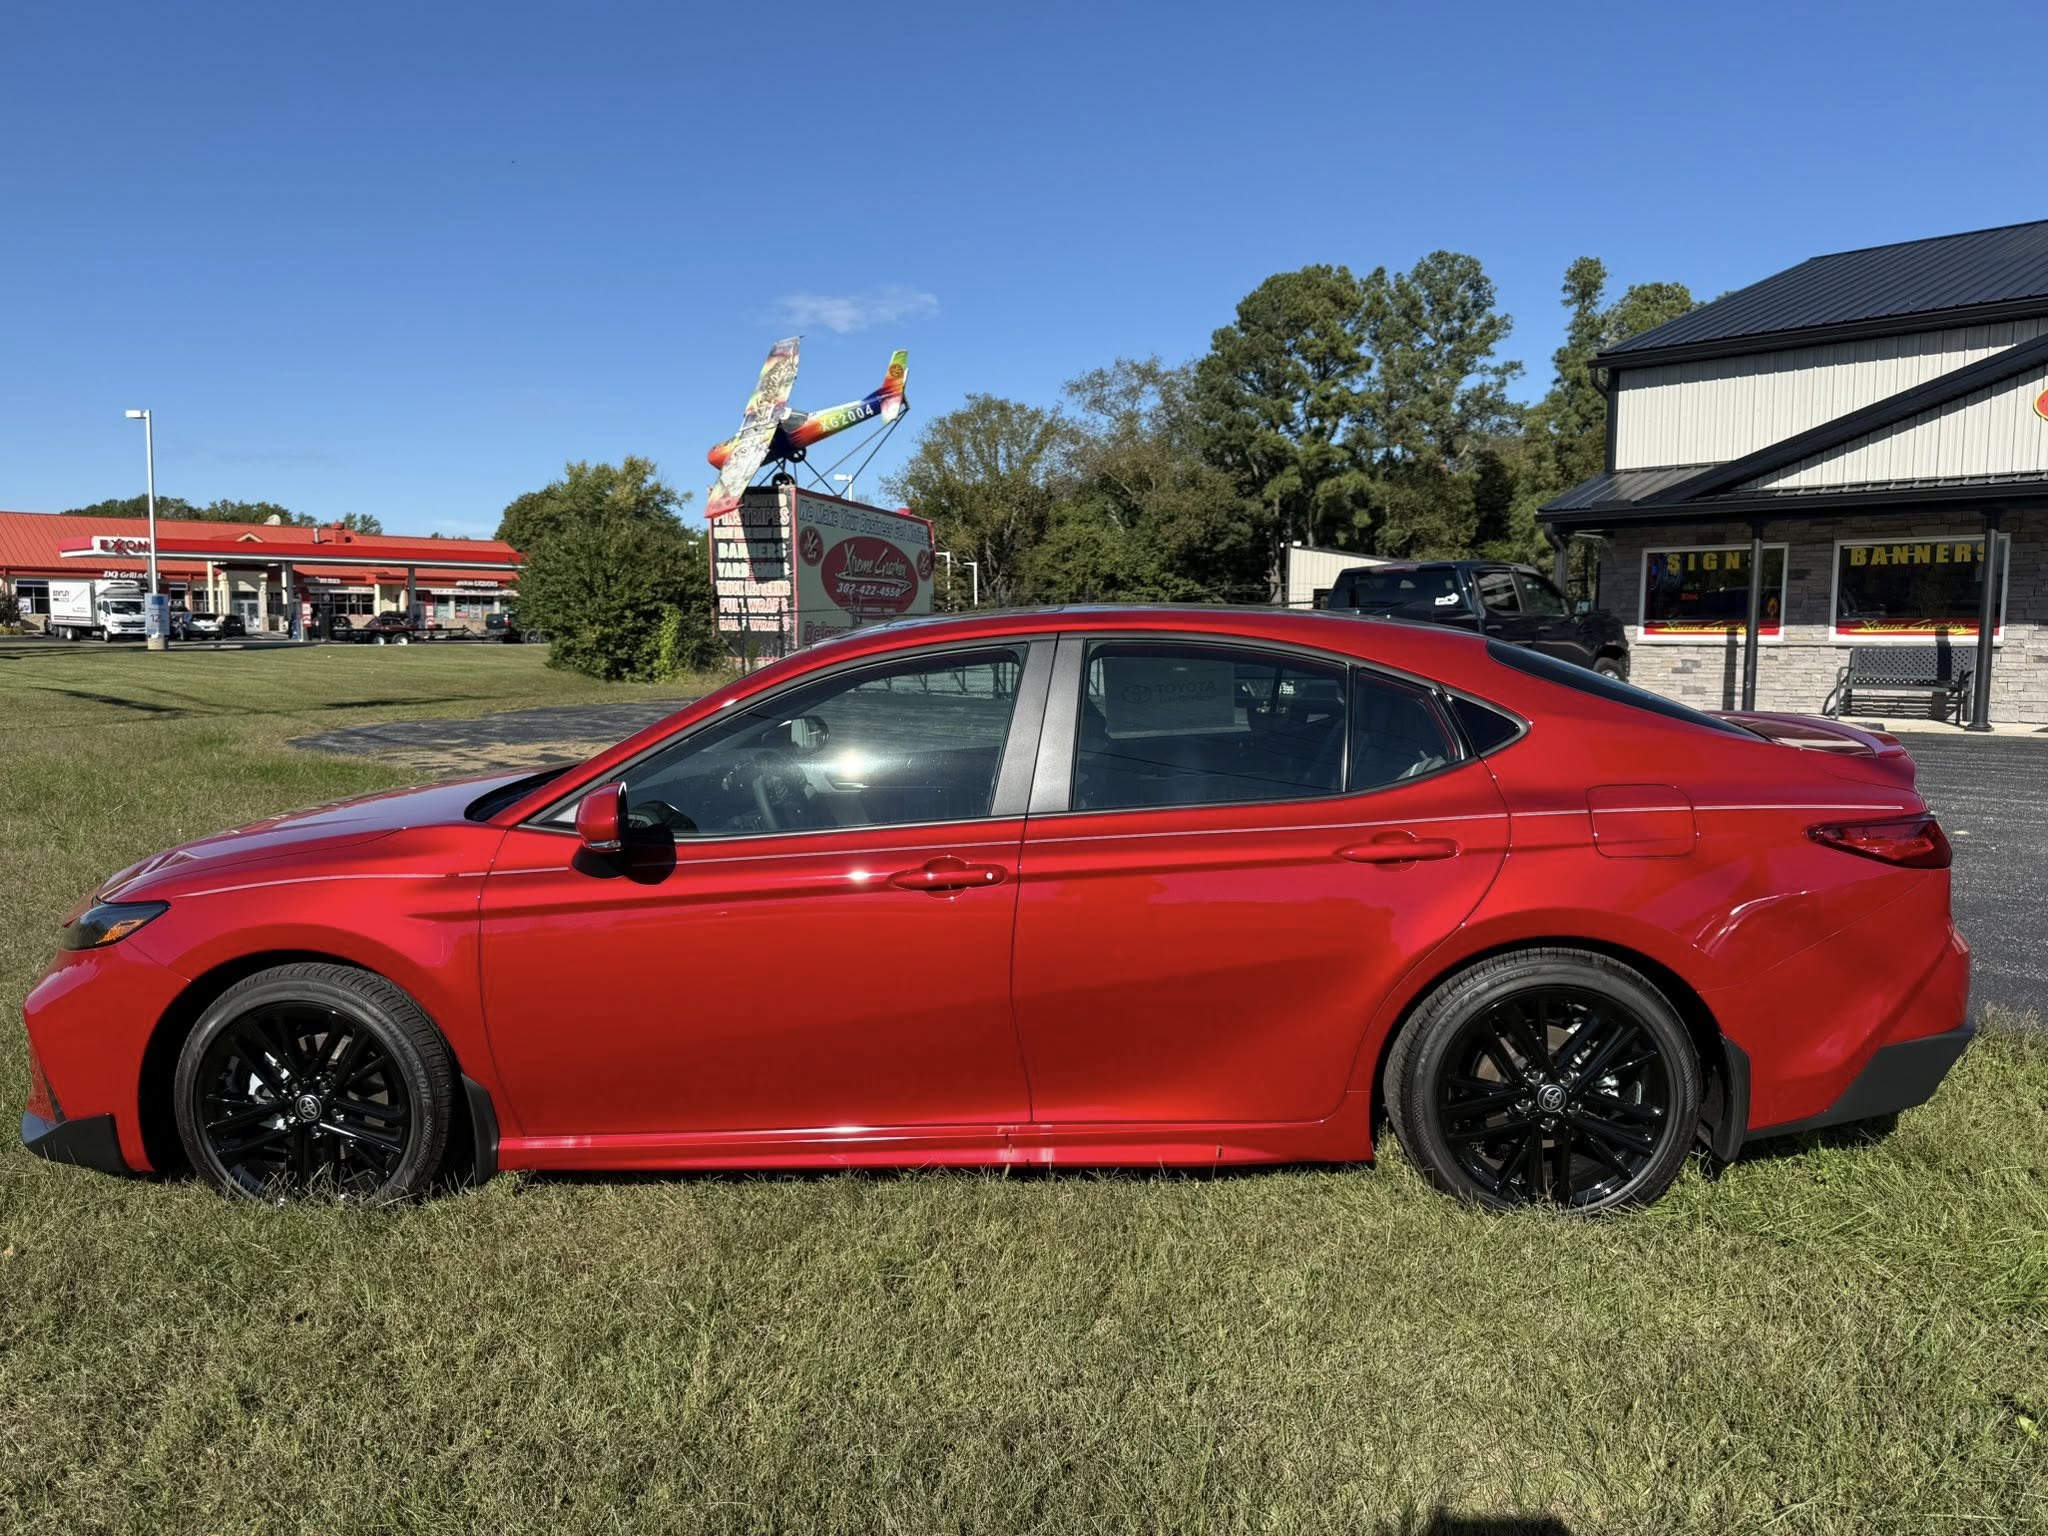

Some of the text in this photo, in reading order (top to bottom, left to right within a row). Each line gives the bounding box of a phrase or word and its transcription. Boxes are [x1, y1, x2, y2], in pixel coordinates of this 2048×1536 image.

[821, 403, 874, 432] XG2004
[1667, 551, 1751, 572] SIGN
[103, 570, 119, 579] DQ
